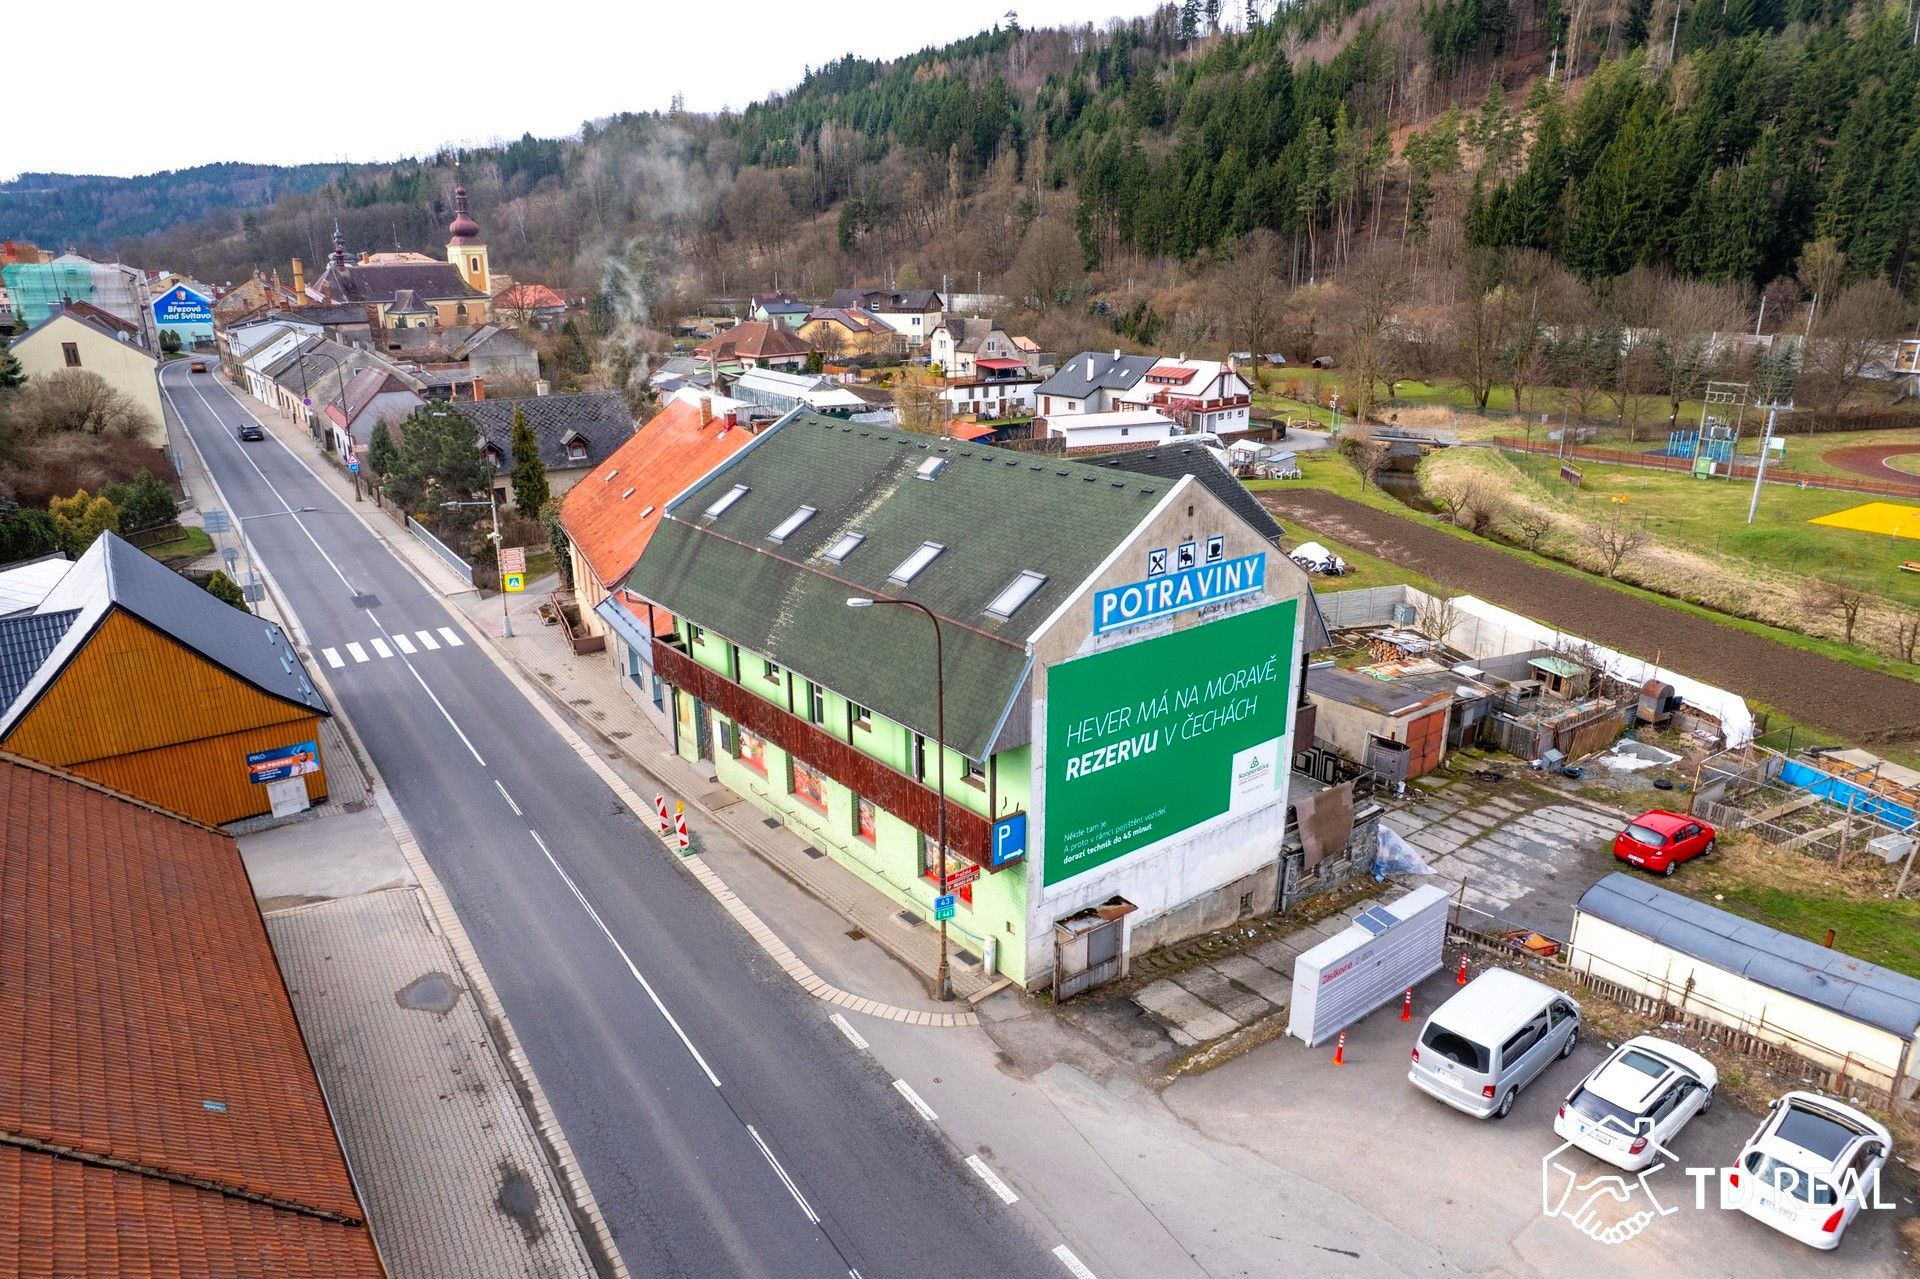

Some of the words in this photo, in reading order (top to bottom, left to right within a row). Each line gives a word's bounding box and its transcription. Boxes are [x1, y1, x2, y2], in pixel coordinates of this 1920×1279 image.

[163, 312, 180, 320] nad
[1102, 557, 1259, 623] POTRAVINY
[1066, 707, 1132, 747] HEVER
[1136, 689, 1169, 724] MÁ
[1174, 685, 1199, 712] NA
[1204, 654, 1277, 702] MORAVĚ,
[1065, 730, 1159, 781] REZERVU
[1164, 723, 1178, 746] V
[1181, 695, 1258, 740] ČECHÁCH
[998, 824, 1011, 857] P
[1086, 824, 1099, 834] tam
[1063, 845, 1069, 854] A
[1070, 838, 1089, 852] proto
[1063, 849, 1086, 865] dorazí
[1086, 839, 1112, 856] technik
[1112, 835, 1122, 844] do
[1122, 830, 1132, 841] 45
[940, 897, 950, 906] 43
